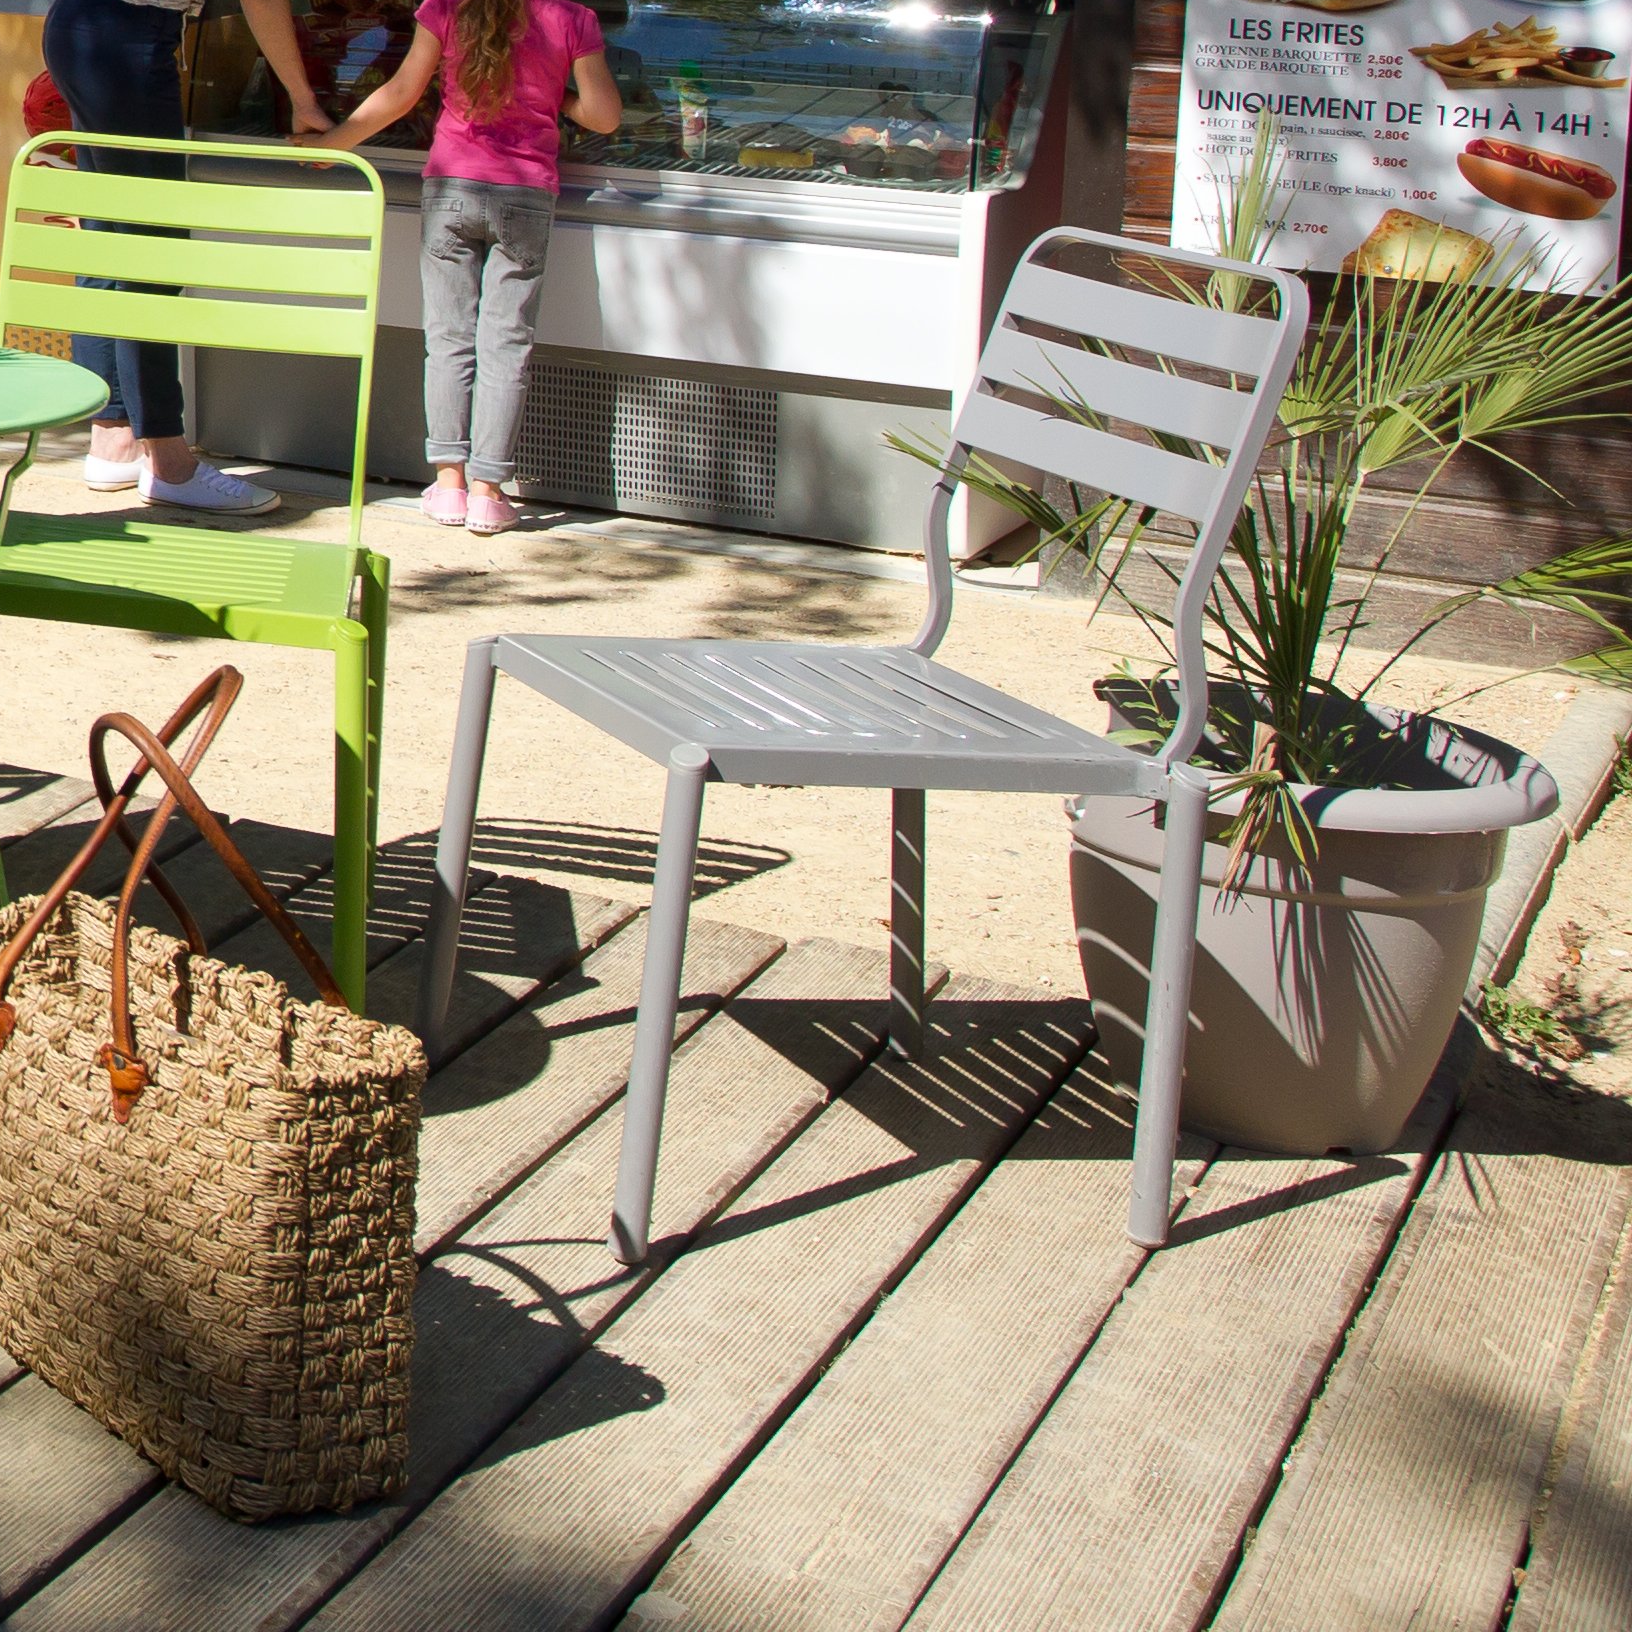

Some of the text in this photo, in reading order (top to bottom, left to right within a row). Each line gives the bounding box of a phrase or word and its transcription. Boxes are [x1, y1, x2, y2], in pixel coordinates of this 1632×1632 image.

[1230, 18, 1364, 46] LES FRITES
[1197, 44, 1403, 65] MOYENNE BARQUETTE 2,50€
[1195, 57, 1402, 79] GRANDE BARQUETTE 3,20€
[1197, 89, 1591, 136] UNIQUEMENT DE 12H À 14H
[1207, 118, 1237, 129] HOT
[1280, 124, 1307, 135] pain,
[1317, 127, 1366, 138] saucisse,
[1205, 144, 1408, 168] HOT FRITES 3,80€
[1277, 178, 1437, 201] SEULE (type knacki) 1,00€
[1294, 223, 1328, 233] 2,70€
